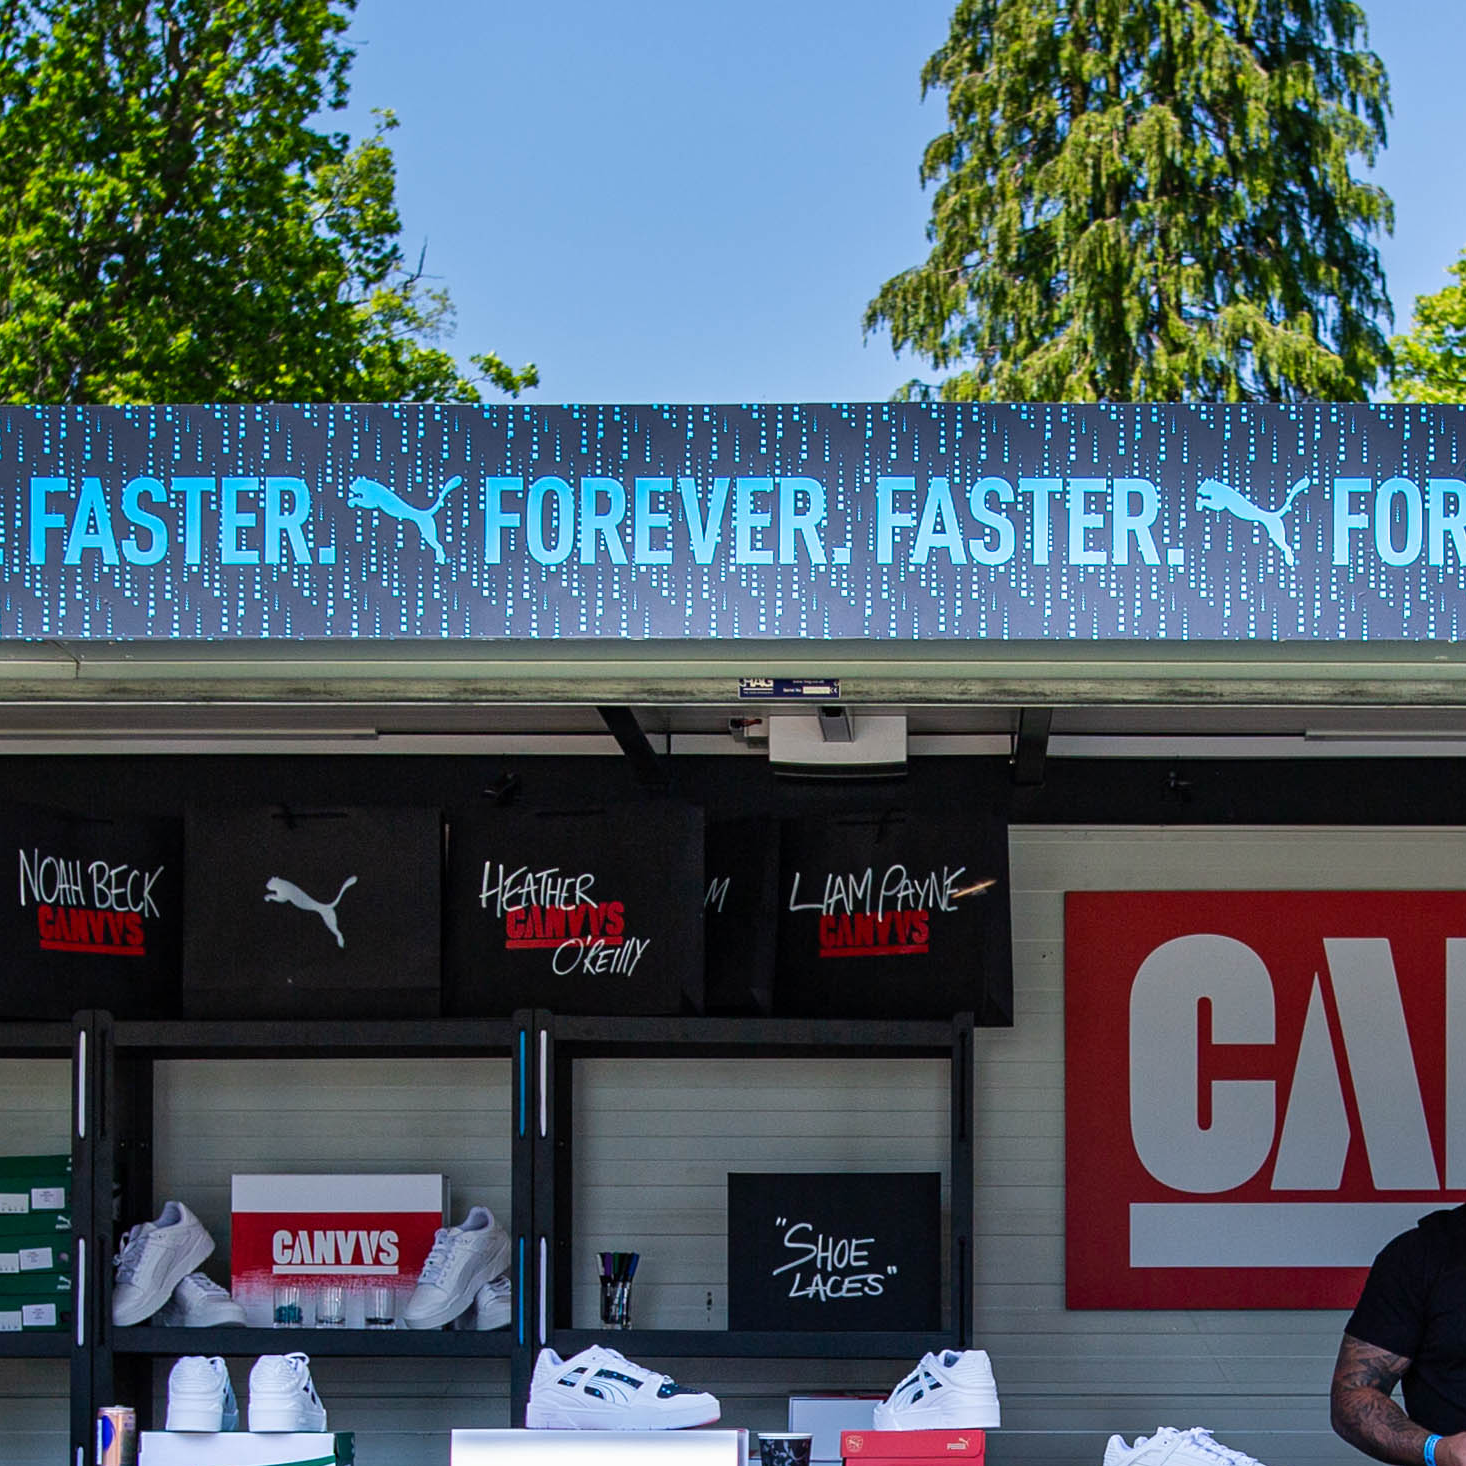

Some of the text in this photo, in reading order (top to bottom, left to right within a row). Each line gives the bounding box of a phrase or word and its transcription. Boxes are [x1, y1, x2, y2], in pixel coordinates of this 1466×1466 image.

[27, 475, 336, 566] FASTER.
[483, 474, 1184, 567] FOREVER. FASTER.
[19, 848, 165, 918] NOAH BECK
[479, 861, 598, 918] HEATHER
[789, 864, 967, 923] LIAM PAYNE
[773, 1216, 875, 1276] "SHOE
[788, 1265, 898, 1302] LACES"
